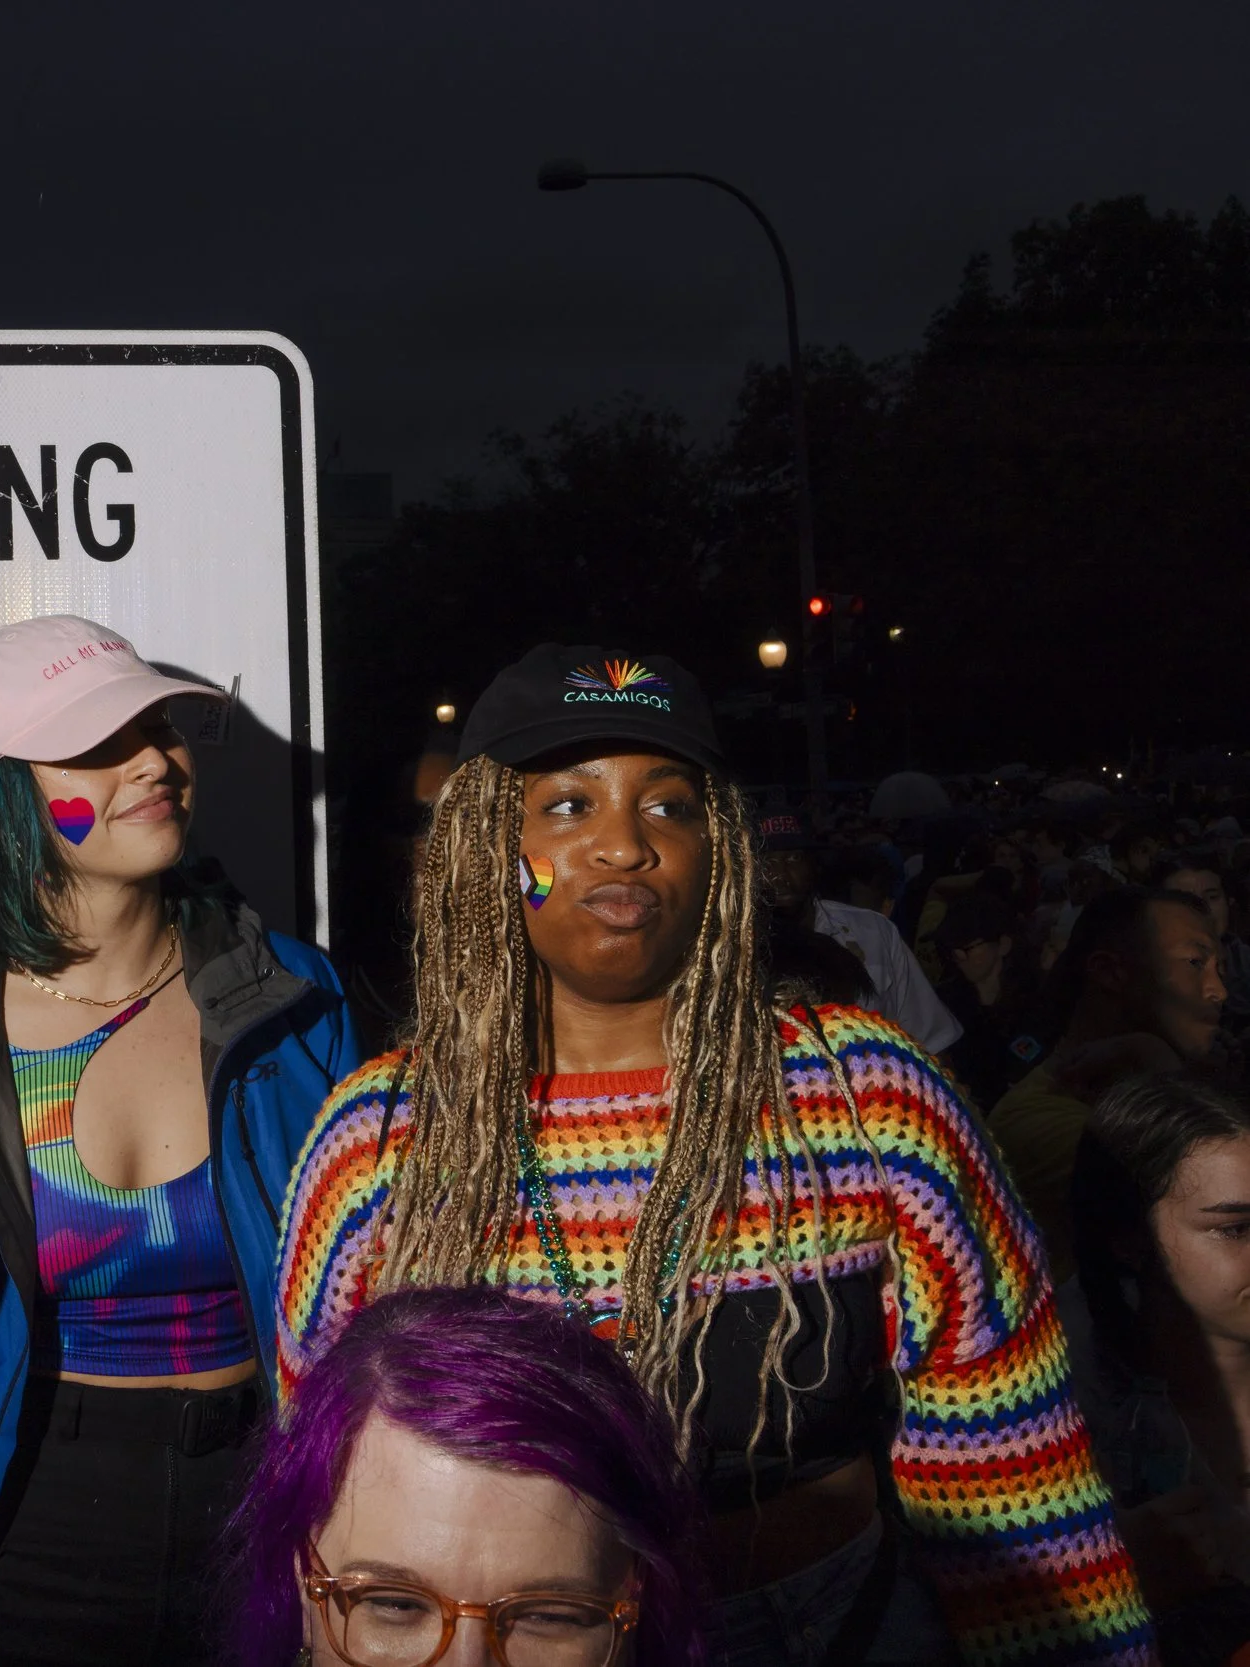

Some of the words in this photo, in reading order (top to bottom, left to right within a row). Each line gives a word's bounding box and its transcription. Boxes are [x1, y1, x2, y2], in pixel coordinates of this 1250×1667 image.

[42, 655, 78, 680] CALL
[78, 644, 98, 660] ME
[564, 691, 671, 712] CASAMIGOS
